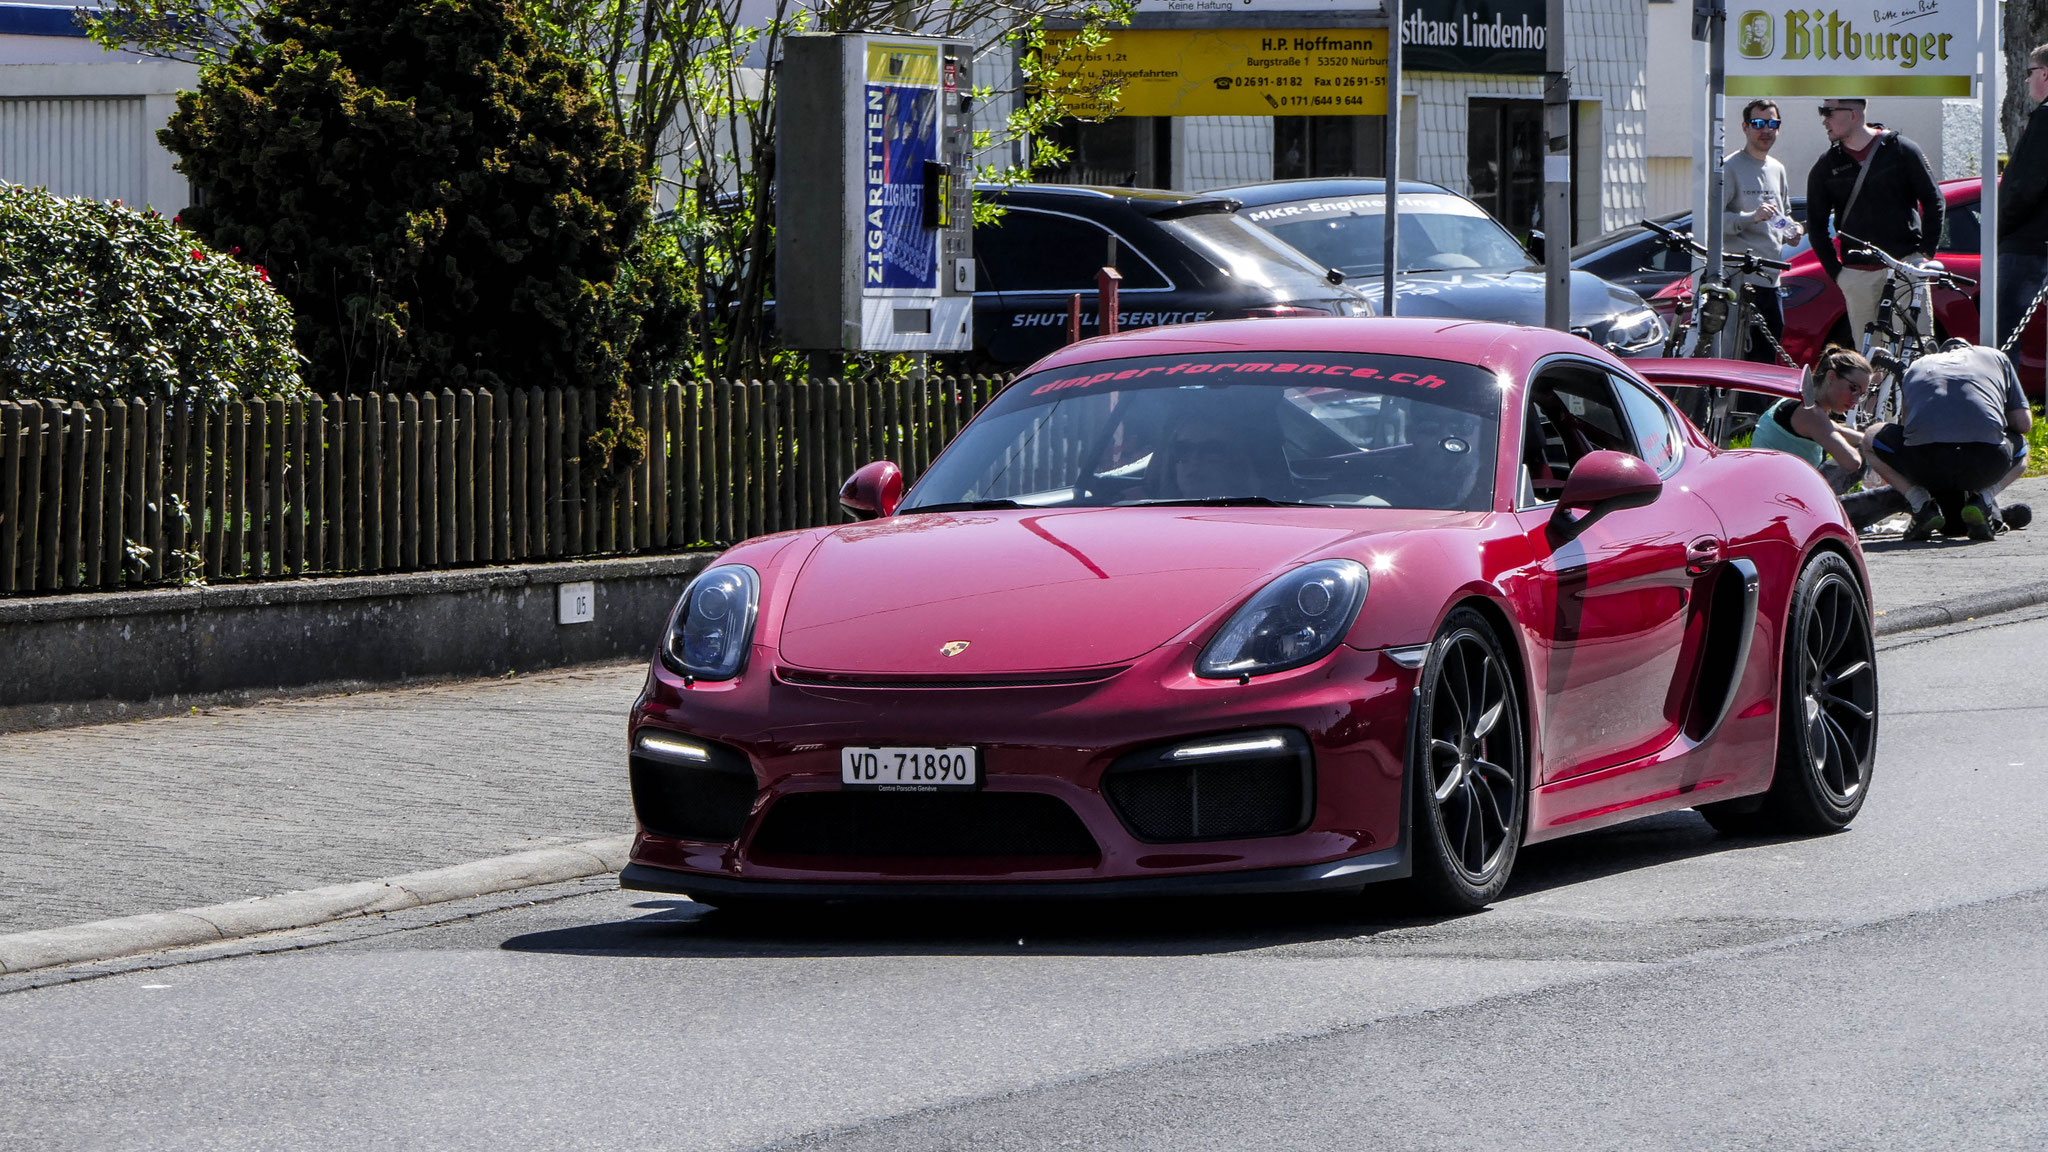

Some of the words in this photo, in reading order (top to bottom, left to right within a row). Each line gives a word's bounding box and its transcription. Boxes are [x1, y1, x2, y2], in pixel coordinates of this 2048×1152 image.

[1168, 2, 1194, 10] Keine
[1196, 2, 1233, 12] Haftung
[1873, 9, 1898, 23] Bitte
[1918, 0, 1939, 12] Bit
[1401, 8, 1458, 46] sthaus
[1463, 11, 1548, 50] Lindenho
[1262, 38, 1289, 51] H.P.
[1293, 37, 1373, 51] Hoffmann
[1781, 9, 1953, 69] Bitburger
[1086, 52, 1102, 61] bis
[1247, 57, 1301, 68] Burgstraße
[1317, 57, 1348, 66] 53520
[1102, 69, 1178, 80] Dialysefahrten
[1314, 77, 1331, 86] Fax
[867, 89, 884, 284] ZIGARETTEN
[883, 184, 925, 206] ZIGARET
[1248, 194, 1442, 222] MKR-Enginering
[1117, 312, 1207, 327] SERVICE
[1030, 362, 1447, 397] dmperformance.ch
